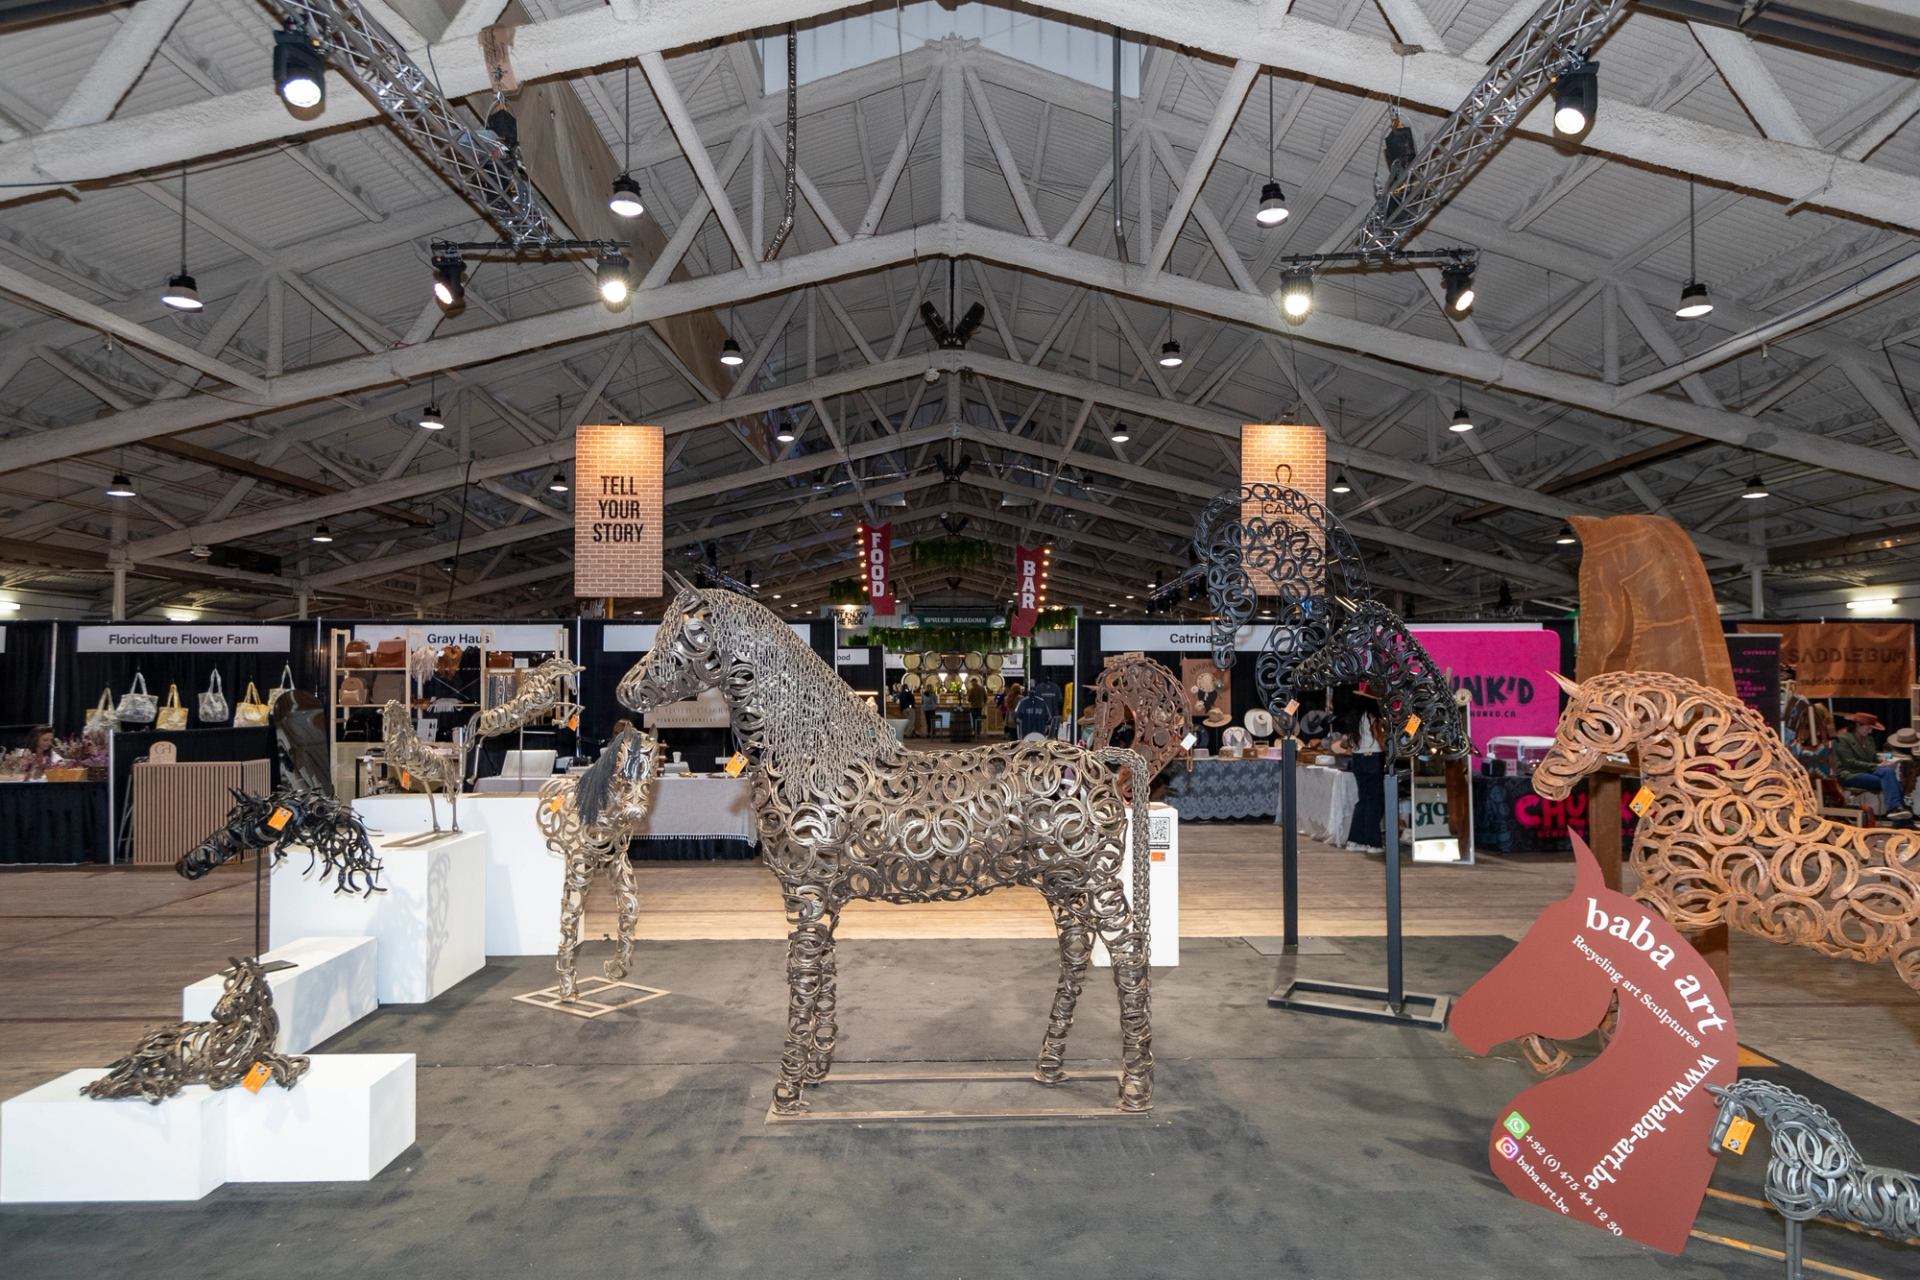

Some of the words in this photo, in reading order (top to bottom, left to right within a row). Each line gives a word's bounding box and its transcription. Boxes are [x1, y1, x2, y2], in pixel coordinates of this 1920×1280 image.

[597, 499, 641, 520] YOUR
[601, 475, 638, 496] TELL
[592, 523, 644, 544] STORY
[870, 532, 885, 597] FOOD
[1021, 560, 1037, 609] BAR
[109, 633, 178, 646] Floriculture
[181, 633, 225, 646] Flower
[228, 633, 259, 646] Farm
[427, 633, 456, 645] Gray
[1572, 934, 1624, 983] Recycling
[1622, 979, 1642, 999] art
[1640, 992, 1701, 1048] Sculptures
[1586, 897, 1677, 971] baba
[1674, 978, 1727, 1035] art
[1585, 1054, 1720, 1190] www.baba-art.be
[1516, 1155, 1571, 1216] baba.art.be
[1523, 1133, 1546, 1157] +32
[1541, 1154, 1561, 1174] (0)
[1559, 1170, 1581, 1192] 475
[1579, 1190, 1595, 1208] 44
[1592, 1204, 1609, 1221] 12
[1606, 1219, 1624, 1238] 30
